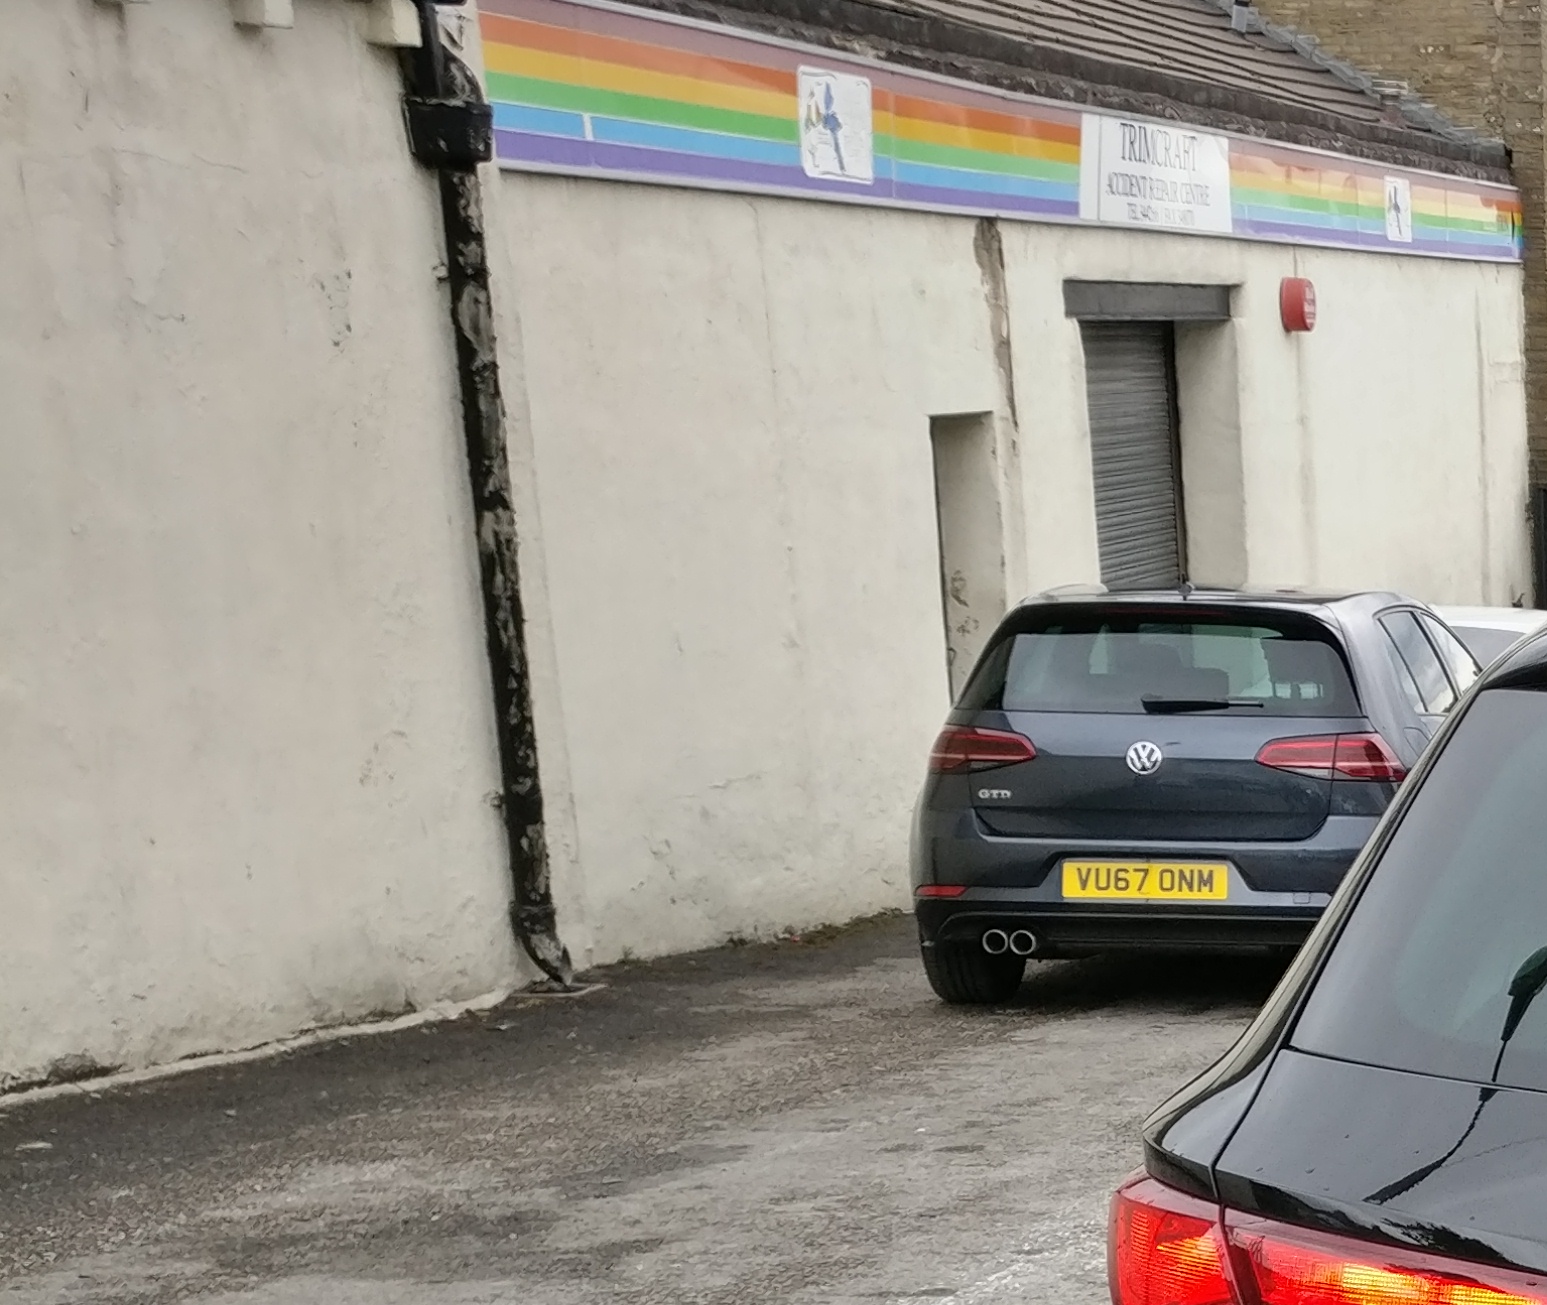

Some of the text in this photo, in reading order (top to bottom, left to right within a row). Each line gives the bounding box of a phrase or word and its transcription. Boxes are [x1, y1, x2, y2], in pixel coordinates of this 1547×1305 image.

[1119, 122, 1198, 171] TRIMCRAFT
[1105, 171, 1211, 206] ACCIDENT REPAIR CENTRE
[1076, 867, 1214, 893] VU67 ONM
